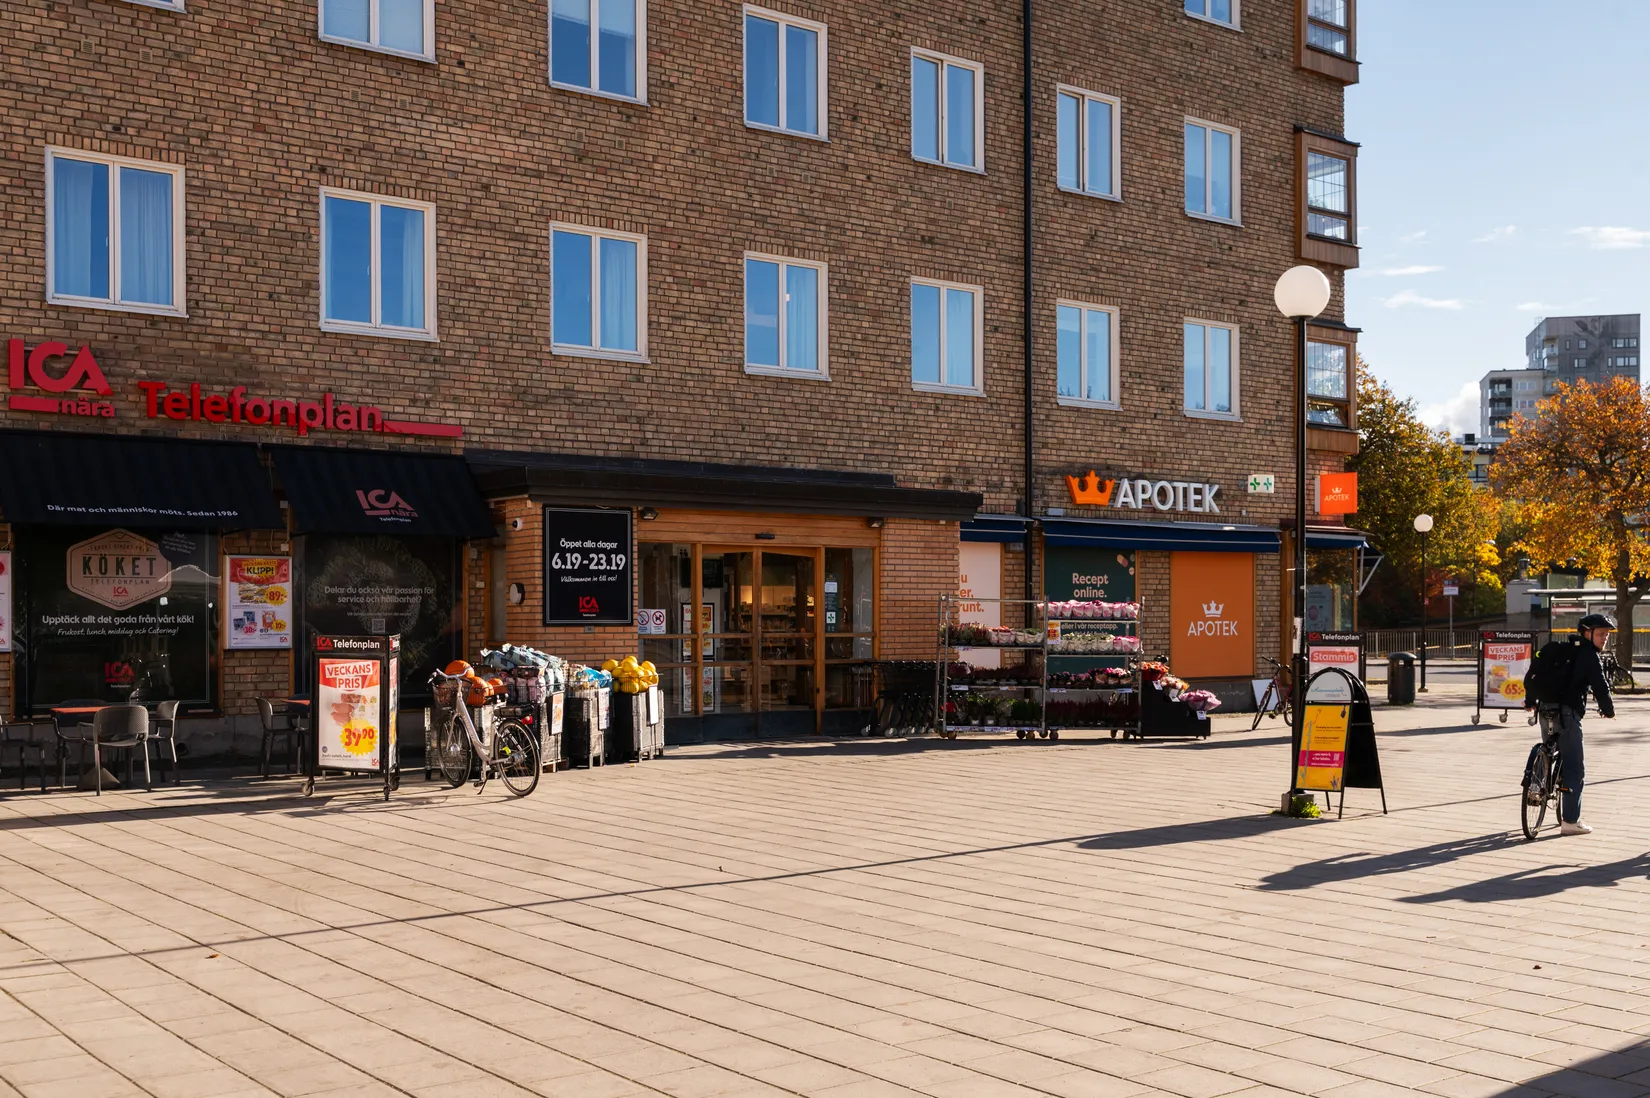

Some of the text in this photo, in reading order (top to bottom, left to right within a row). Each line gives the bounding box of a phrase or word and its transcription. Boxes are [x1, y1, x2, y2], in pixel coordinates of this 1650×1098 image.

[9, 338, 113, 395] ICA
[60, 397, 115, 418] nära
[138, 381, 383, 435] Telefonplan
[356, 489, 414, 511] ICA
[1114, 478, 1220, 512] APOTEK
[391, 509, 418, 517] nära
[560, 538, 618, 550] Öppet alla dagar
[82, 554, 156, 575] KÖKET
[1072, 572, 1109, 587] Recept
[325, 586, 345, 594] Delar
[347, 586, 356, 594] du
[358, 586, 380, 594] också
[381, 586, 392, 594] vår
[394, 586, 422, 595] passion
[1074, 586, 1107, 598] online.
[381, 595, 422, 603] hållbarhet?
[580, 596, 599, 608] ICA
[42, 615, 194, 625] Upptäck allt det goda från vårt kök!
[108, 628, 133, 636] middag
[148, 627, 179, 636] Catering!
[1188, 621, 1238, 636] APOTEK
[317, 636, 332, 647] ICA
[333, 639, 380, 649] Telefonplan
[1314, 652, 1354, 660] Stammis
[1490, 646, 1524, 654] VECKANS
[105, 661, 134, 677] ICA
[327, 664, 371, 676] VECKANS
[338, 678, 360, 688] PRIS
